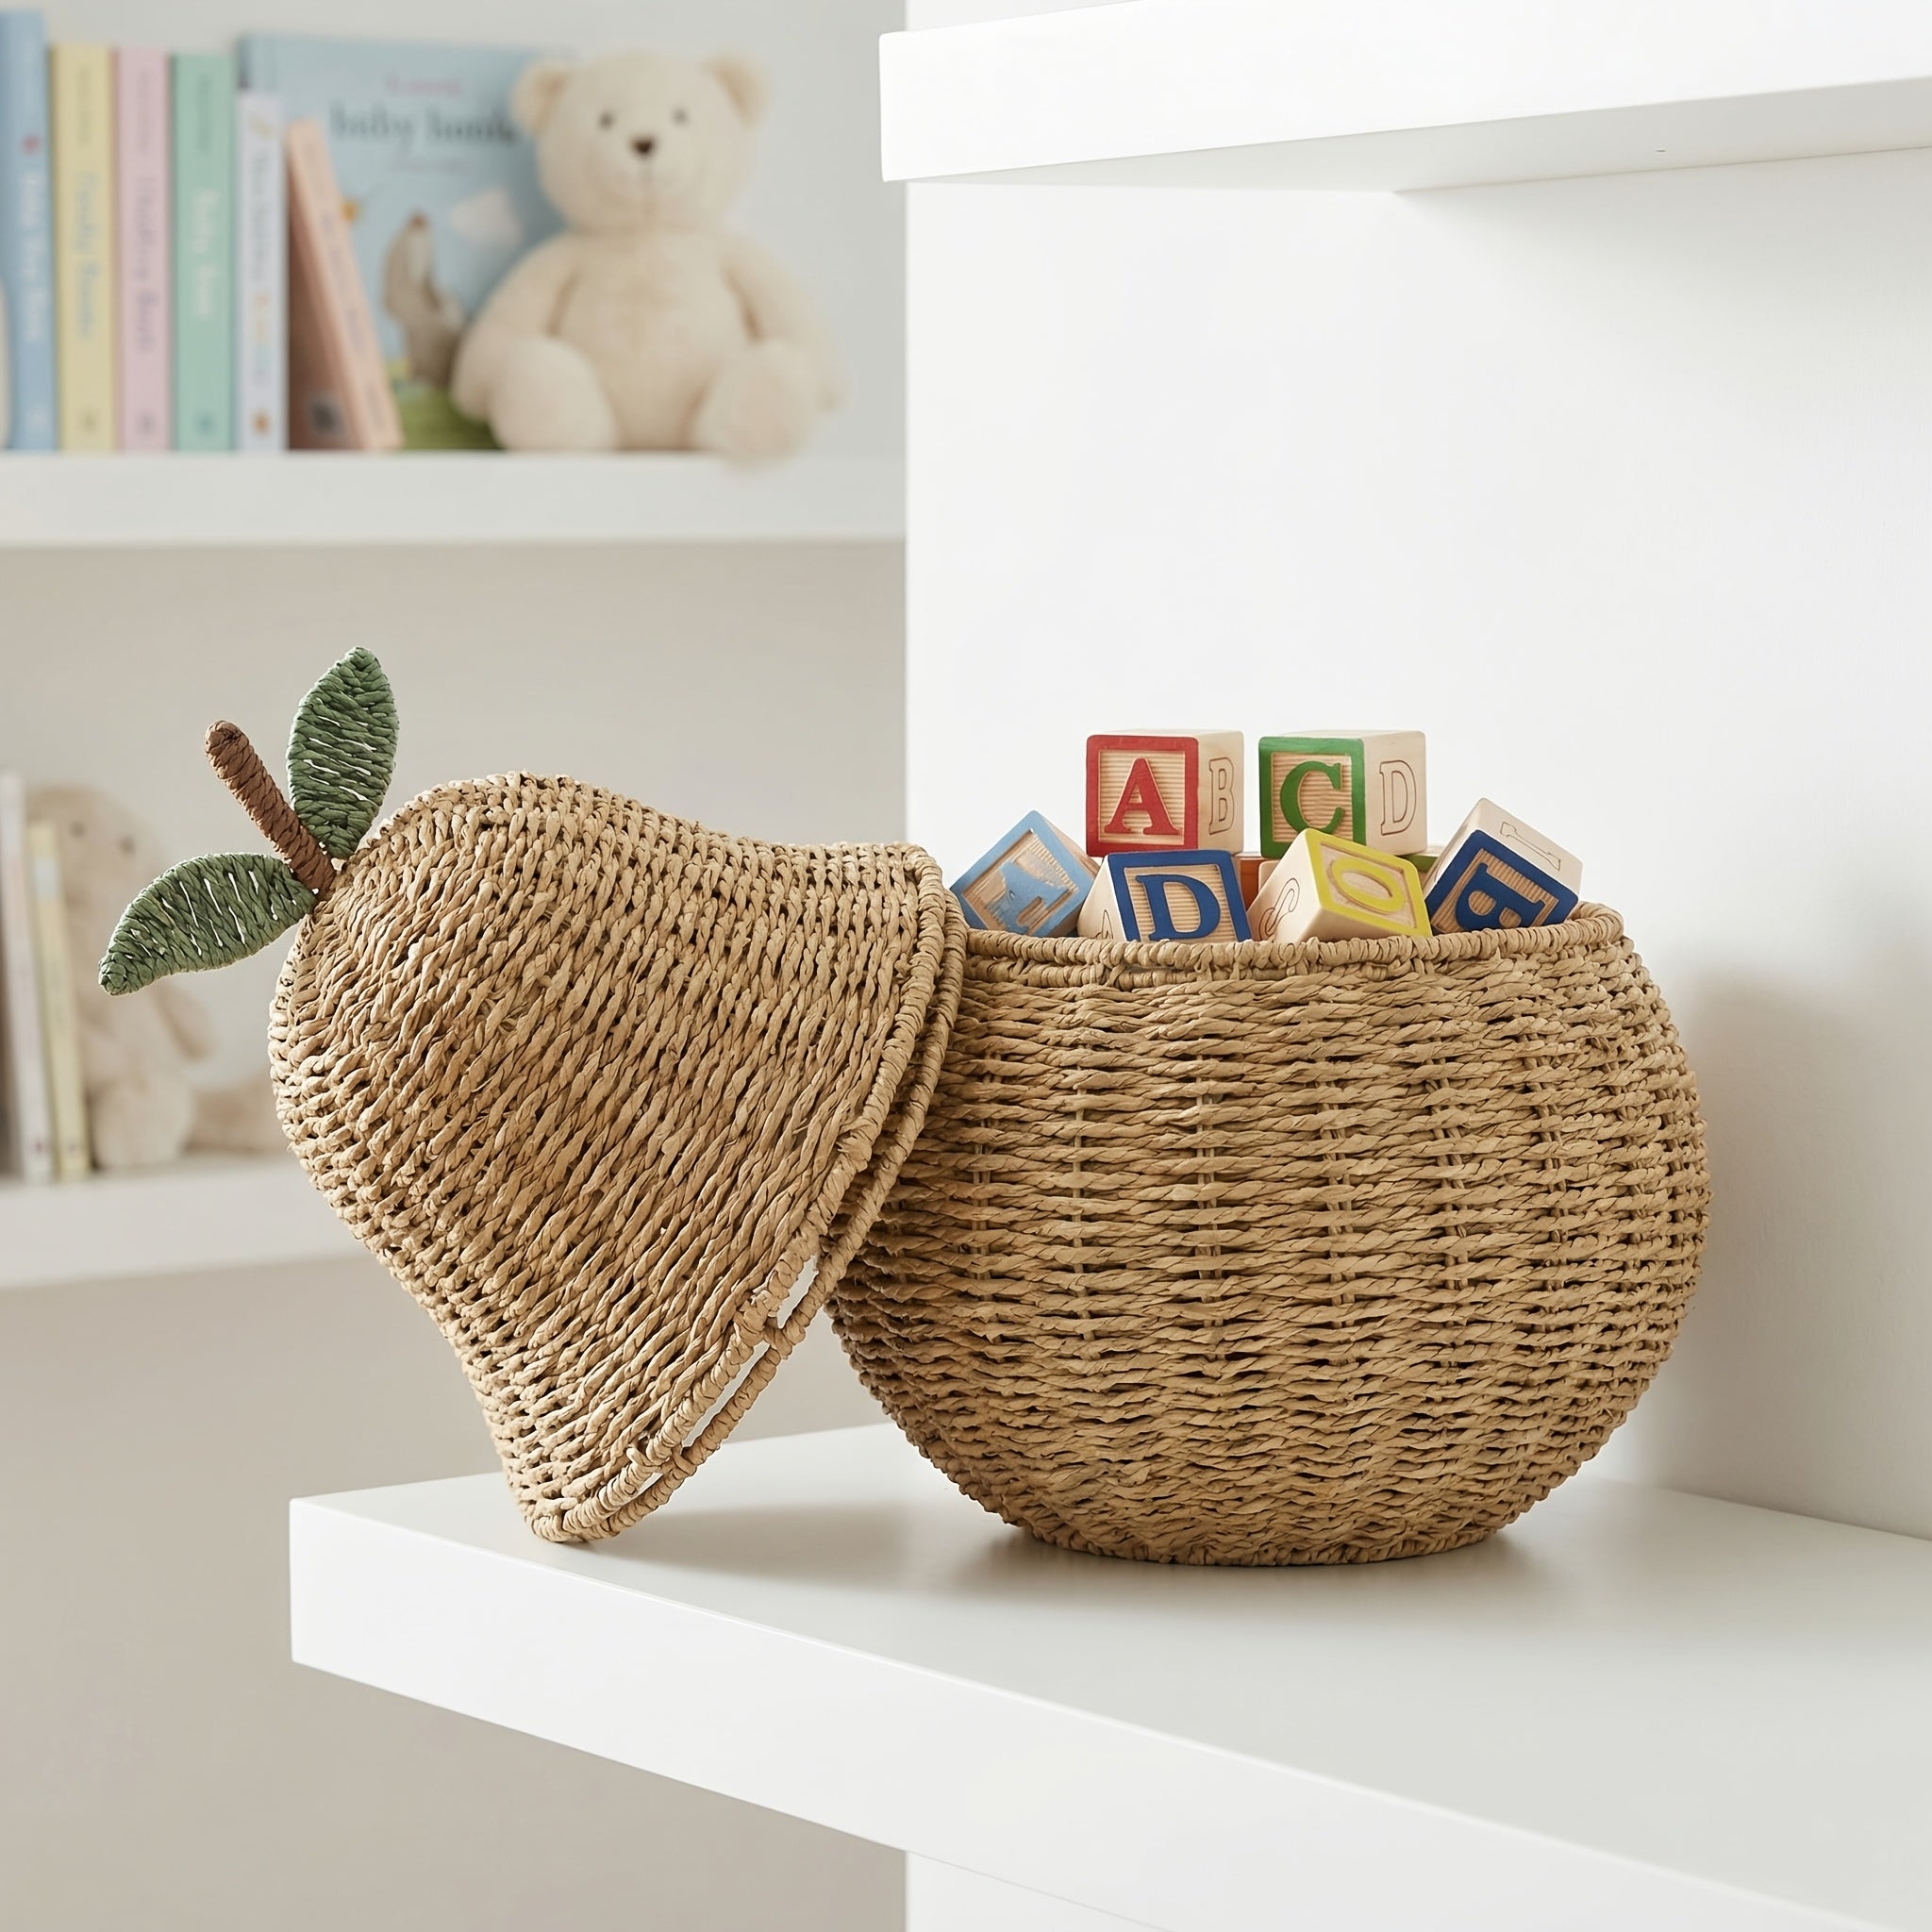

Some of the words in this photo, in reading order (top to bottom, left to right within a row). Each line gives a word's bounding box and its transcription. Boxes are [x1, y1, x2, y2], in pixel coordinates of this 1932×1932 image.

[1104, 757, 1182, 835] A
[1208, 757, 1234, 835] B
[1279, 760, 1344, 834] C
[1379, 759, 1417, 836] D
[1135, 874, 1221, 941] D
